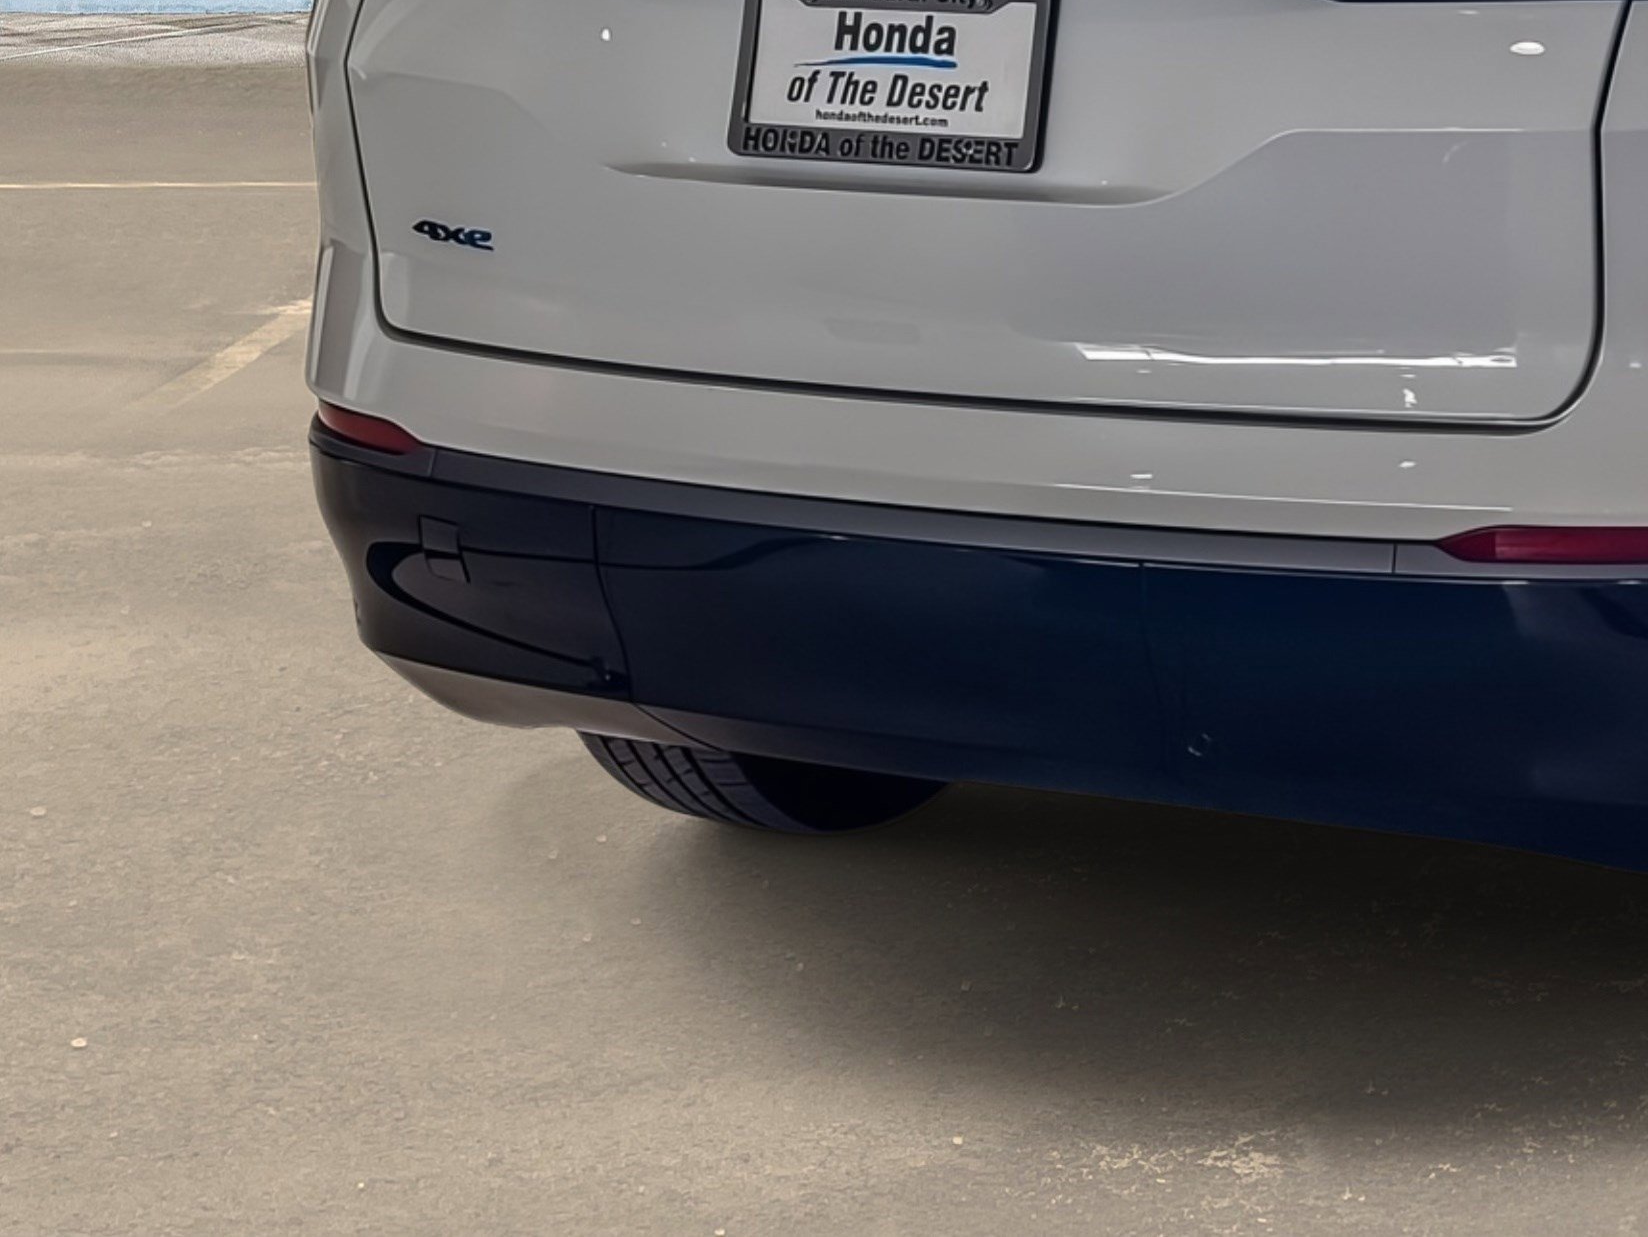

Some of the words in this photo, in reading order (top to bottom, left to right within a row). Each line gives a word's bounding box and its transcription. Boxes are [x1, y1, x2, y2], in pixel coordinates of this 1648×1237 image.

[834, 11, 957, 56] Honda
[787, 70, 821, 103] of
[827, 71, 878, 106] The
[886, 74, 989, 112] Desert
[815, 109, 948, 128] hondaofthedesert.com
[742, 127, 831, 155] HONDA
[839, 130, 865, 157] of
[870, 132, 910, 160] the
[918, 137, 1020, 166] DESERT
